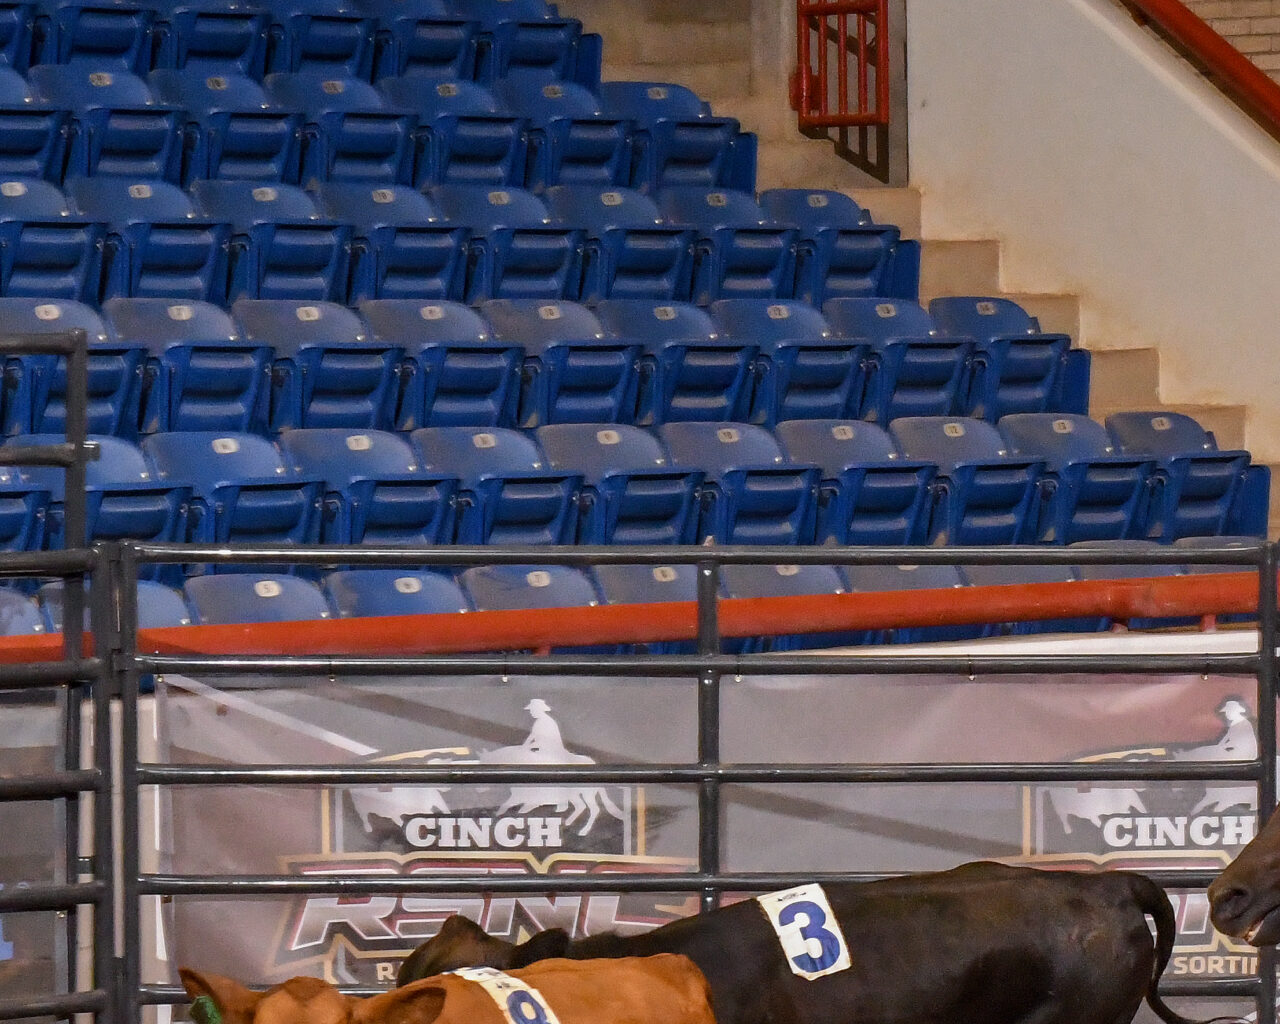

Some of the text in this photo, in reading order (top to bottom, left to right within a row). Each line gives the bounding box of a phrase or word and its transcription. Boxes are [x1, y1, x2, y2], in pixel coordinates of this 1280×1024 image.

[405, 817, 563, 847] CINCH
[1103, 816, 1256, 847] CINCH
[779, 901, 840, 973] 3
